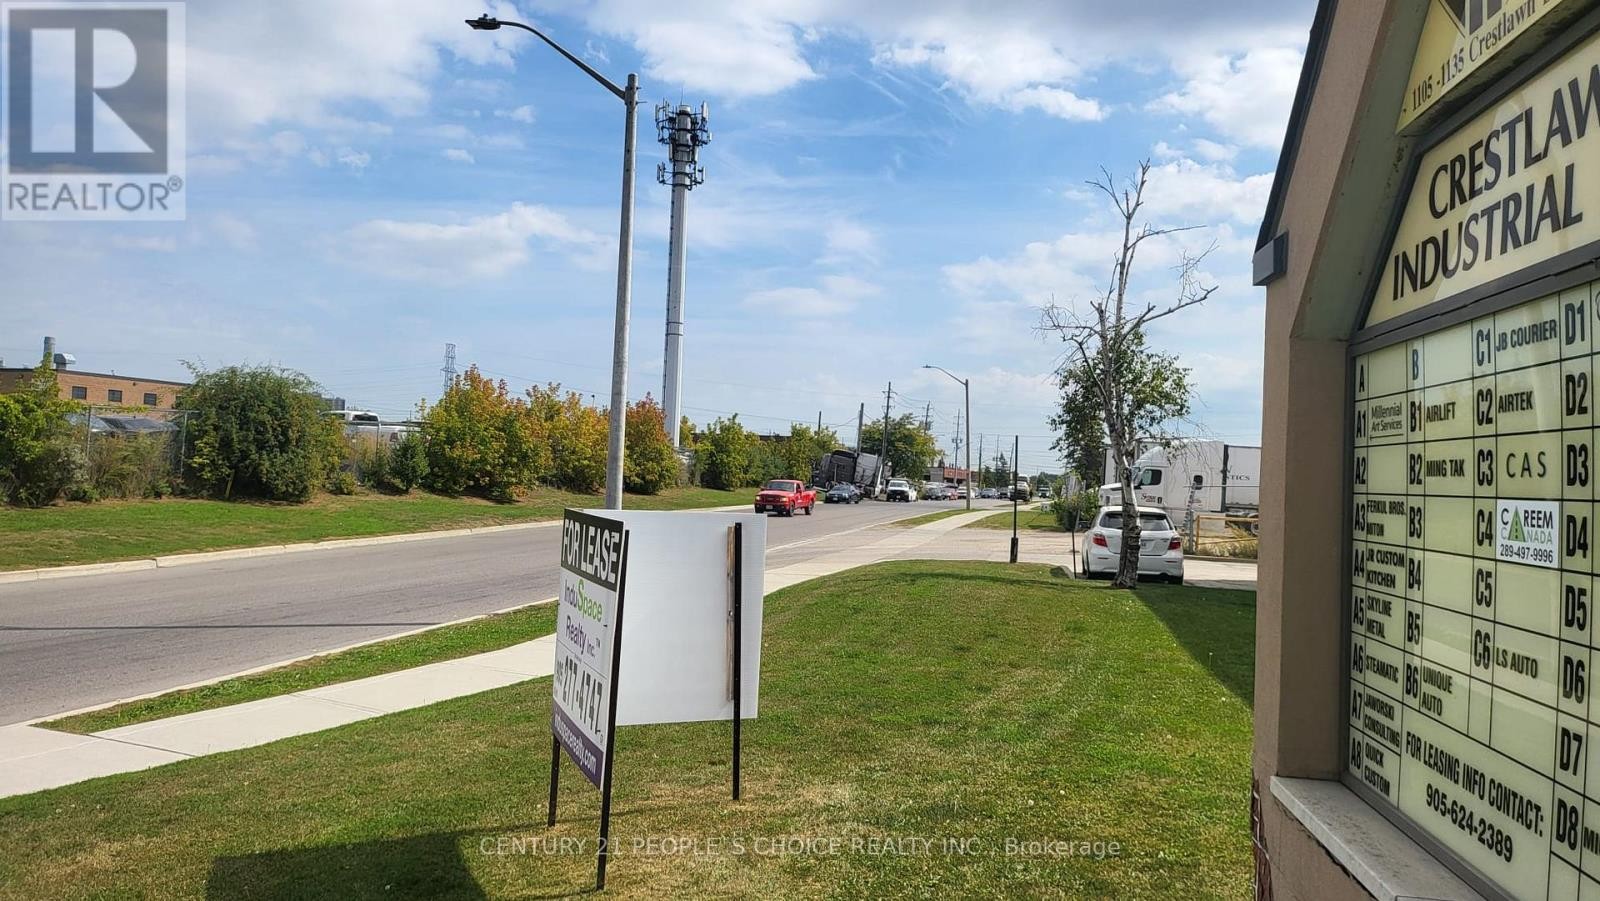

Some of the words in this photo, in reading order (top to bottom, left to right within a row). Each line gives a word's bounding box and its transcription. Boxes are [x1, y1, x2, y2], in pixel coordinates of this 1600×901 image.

[1412, 75, 1433, 111] 1105
[1469, 0, 1536, 62] Crestlawn
[1392, 162, 1583, 302] INDUSTRIAL
[1496, 332, 1507, 352] JB
[1510, 319, 1557, 348] COURIER
[1565, 300, 1585, 346] D1
[1476, 328, 1491, 366] C1
[1359, 364, 1365, 393] A
[1412, 349, 1419, 380] B
[1476, 388, 1493, 426] C2
[1498, 390, 1533, 414] AIRTEK
[1565, 372, 1588, 416] D2
[1356, 410, 1366, 438] A1
[1371, 402, 1402, 420] Millennial
[1371, 421, 1380, 432] Art
[1380, 418, 1402, 431] Services
[1410, 400, 1422, 432] B1
[1425, 401, 1456, 423] AIRLIFT
[1355, 457, 1366, 485] A2
[1409, 453, 1422, 485] B2
[1426, 459, 1447, 478] MING
[1449, 459, 1465, 477] TAK
[1477, 449, 1493, 486] C3
[1566, 443, 1588, 487] D3
[1354, 502, 1366, 532] A3
[1409, 506, 1422, 539] B3
[1476, 509, 1493, 547] C4
[562, 518, 581, 568] FOR
[580, 523, 620, 584] LEASE
[1566, 514, 1588, 559] D4
[1353, 548, 1365, 578] A4
[1376, 549, 1405, 568] CUSTOM
[1500, 543, 1553, 564] 289-497-9996
[1366, 569, 1396, 589] KITCHEN
[1408, 557, 1421, 591] B4
[1476, 568, 1492, 608] C5
[564, 578, 602, 623] InduSpace
[1353, 595, 1364, 626] A5
[1367, 595, 1392, 618] SKYLINE
[1565, 585, 1587, 631] D5
[566, 614, 586, 655] Realty
[1366, 619, 1385, 639] METAL
[1407, 610, 1420, 646] B5
[1352, 642, 1364, 674] A6
[1474, 629, 1491, 670] C6
[1496, 647, 1507, 668] LS
[1510, 652, 1537, 679] AUTO
[1366, 655, 1399, 683] STEAMATIC
[1405, 663, 1419, 699] B6
[1423, 665, 1453, 694] UNIQUE
[1563, 655, 1585, 704] D6
[1351, 690, 1363, 721] A7
[1421, 691, 1443, 716] AUTO
[1364, 714, 1400, 749] CONSULTING
[1351, 738, 1361, 771] A8
[1365, 742, 1384, 769] QUICK
[1560, 727, 1583, 776] D7
[1364, 765, 1390, 798] CUSTOM
[1406, 731, 1421, 762] FOR
[1423, 740, 1460, 785] LEASING
[1462, 763, 1485, 801] INFO
[1489, 777, 1544, 838] CONTACT:
[1426, 783, 1513, 863] 905-624-2389
[1556, 798, 1579, 851] D8
